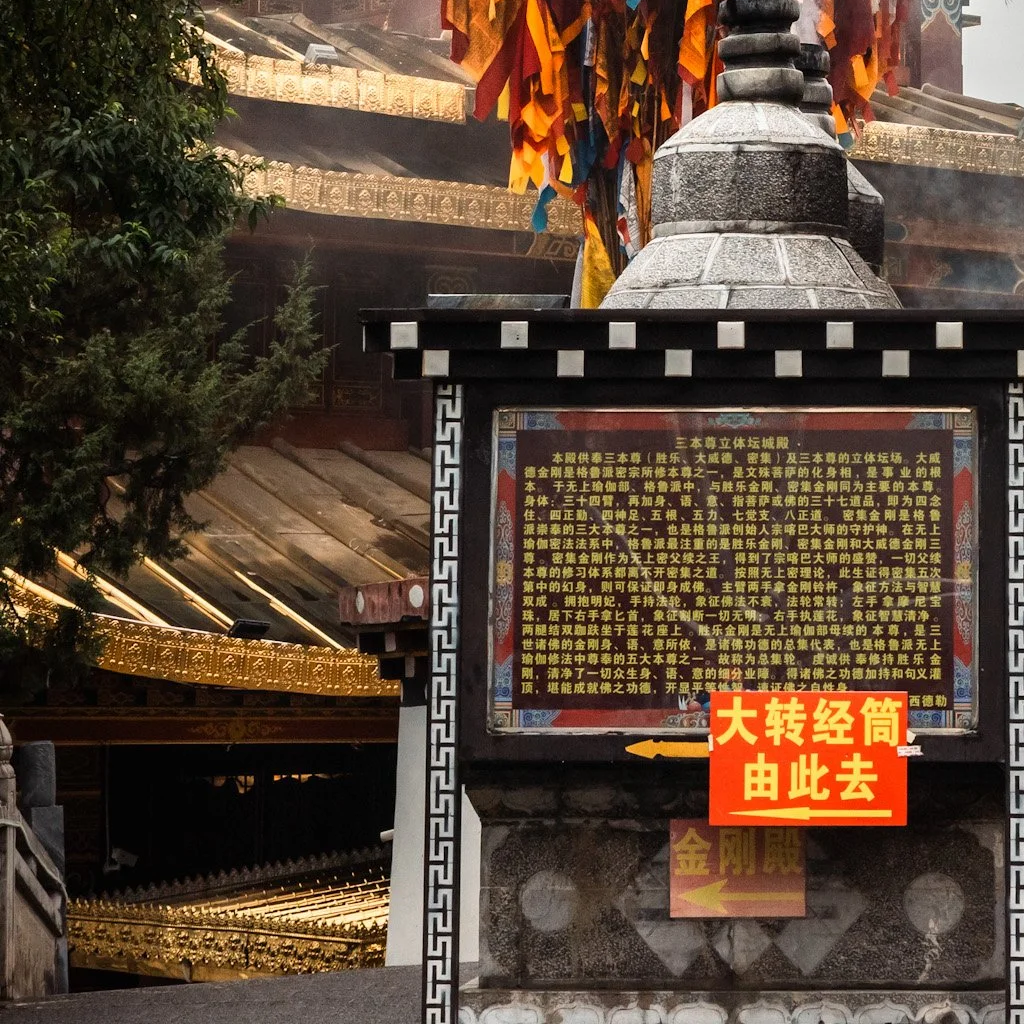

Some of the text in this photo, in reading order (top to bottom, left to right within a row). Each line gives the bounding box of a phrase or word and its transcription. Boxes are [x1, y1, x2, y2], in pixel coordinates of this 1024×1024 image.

[675, 436, 789, 449] 三本尊立体坛城殿
[908, 694, 948, 708] 西德勒
[716, 696, 903, 747] 大转经筒
[743, 752, 879, 802] 由此去
